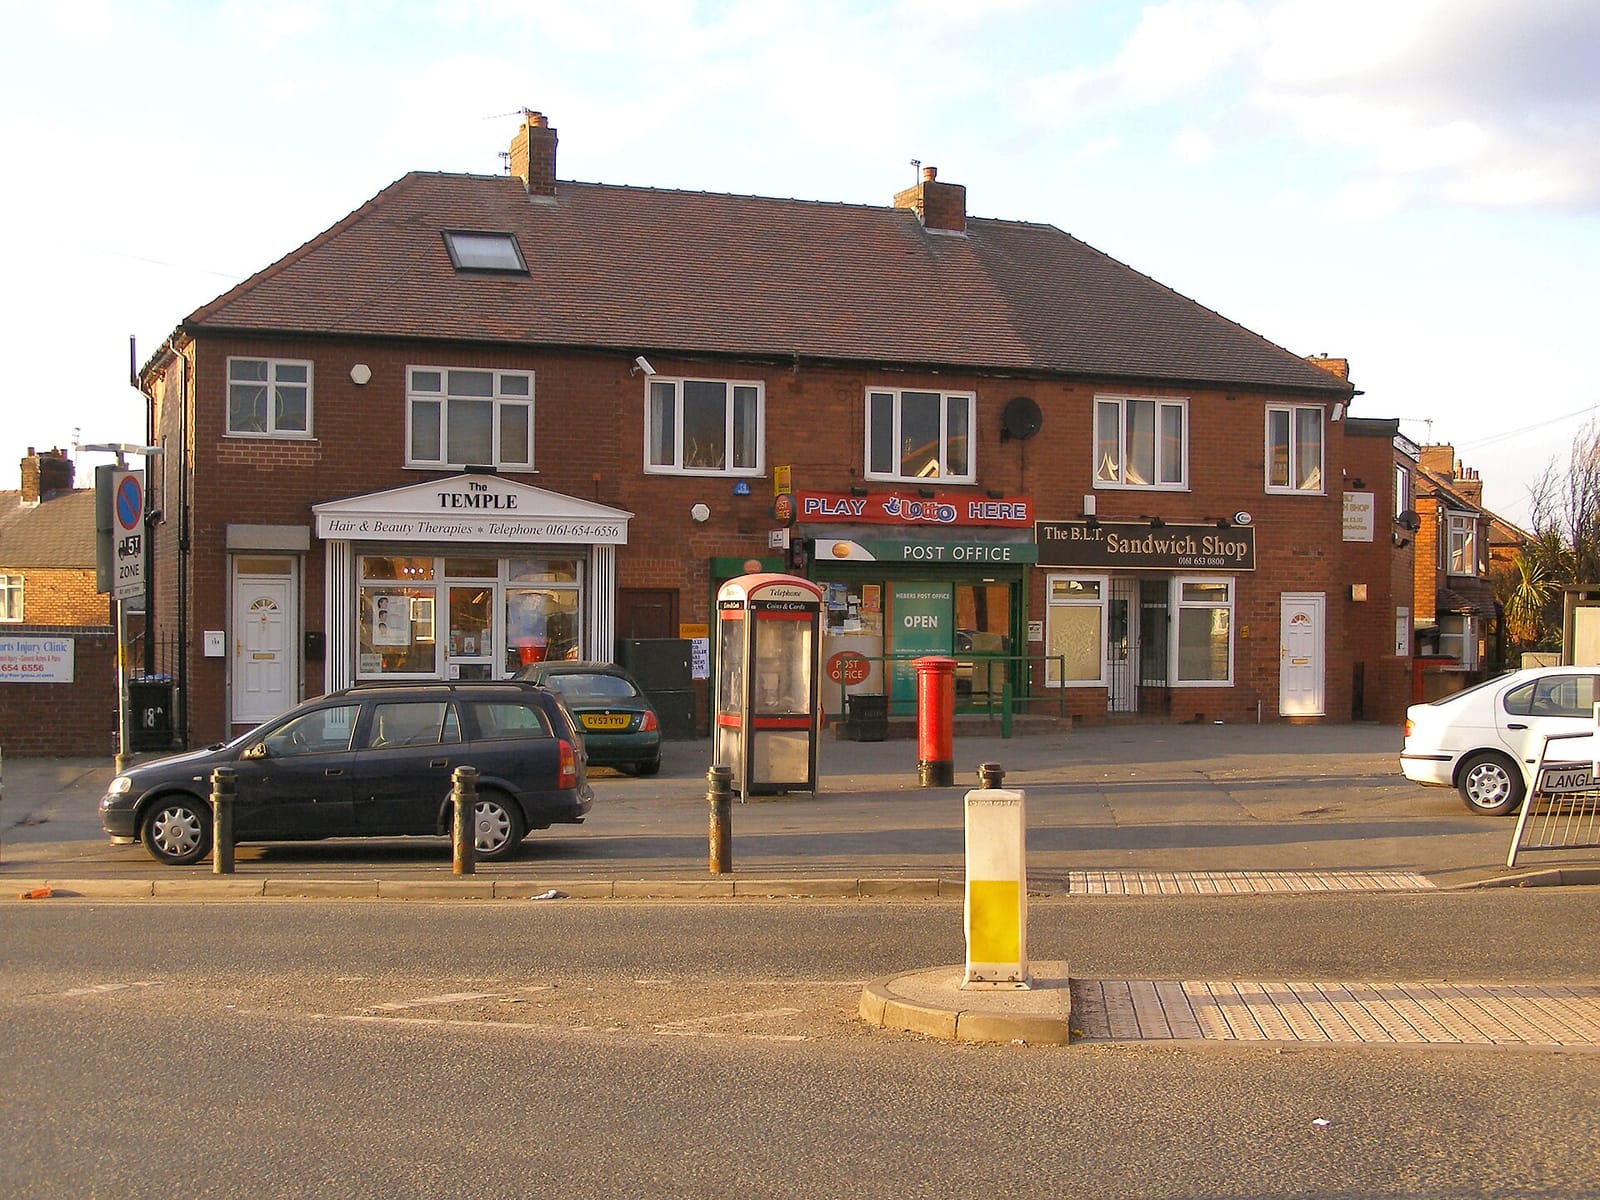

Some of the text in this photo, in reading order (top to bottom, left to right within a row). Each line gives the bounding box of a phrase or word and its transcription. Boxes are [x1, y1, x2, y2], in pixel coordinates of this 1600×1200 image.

[469, 482, 487, 491] The
[438, 493, 518, 509] TEMPLE
[805, 498, 866, 515] PLAY
[969, 502, 1026, 520] HERE
[329, 520, 618, 537] Hair & Beauty Therapies Telephone 0161-654-6556
[1044, 527, 1248, 561] The B.L.T. Sandwich Shop
[904, 546, 1011, 561] POST OFFICE
[1178, 557, 1225, 566] 0161 653 0800
[120, 564, 140, 579] ZONE
[770, 589, 802, 597] Telephone
[782, 602, 788, 610] &
[904, 615, 938, 628] OPEN
[17, 641, 40, 654] Injury
[44, 641, 67, 652] Clinic
[1, 664, 45, 672] 654 6556
[588, 717, 624, 725] CV53 YYU
